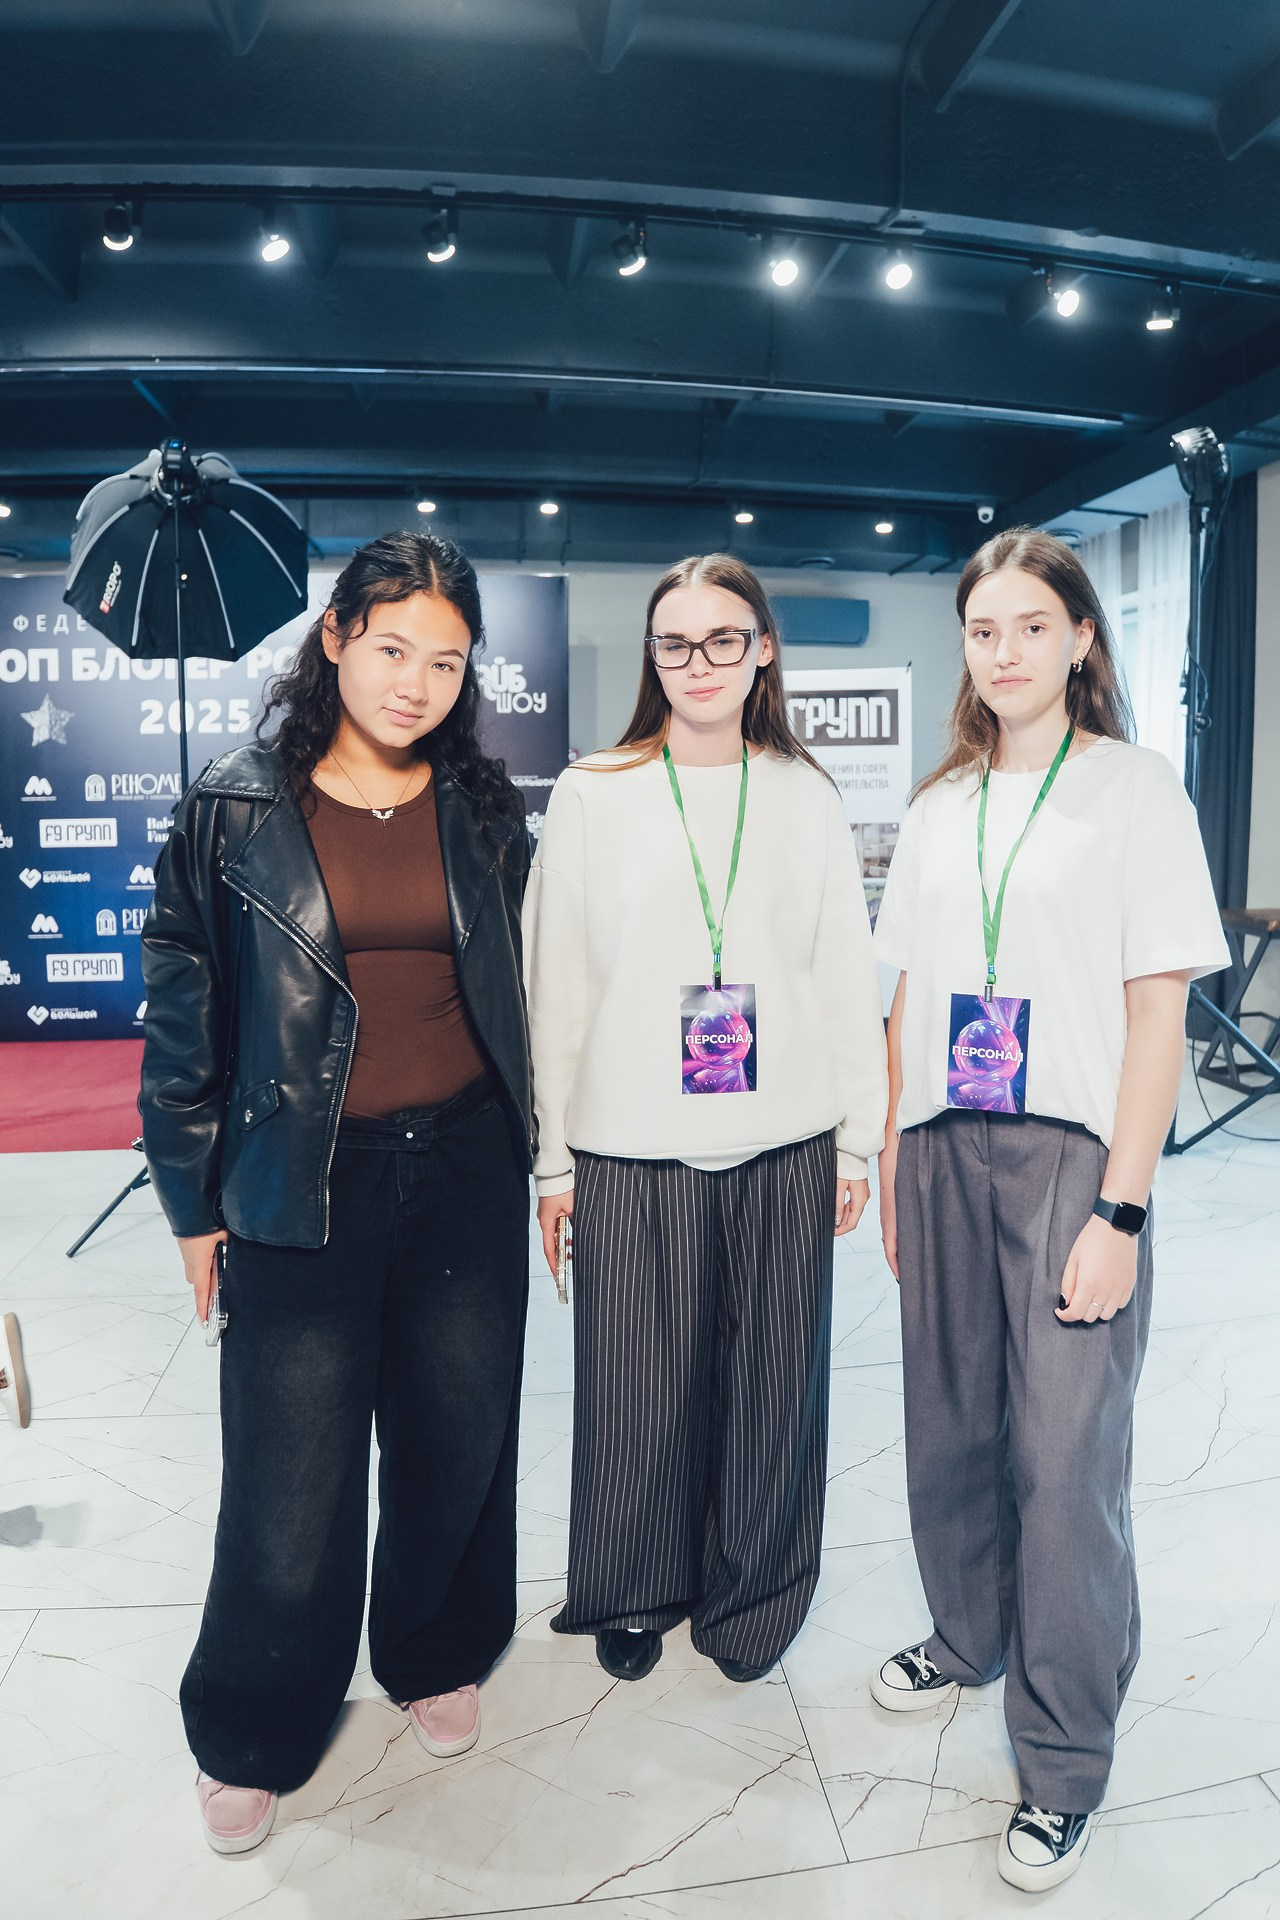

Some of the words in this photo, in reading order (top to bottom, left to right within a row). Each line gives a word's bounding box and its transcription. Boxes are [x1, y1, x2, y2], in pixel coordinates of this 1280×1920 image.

[13, 614, 87, 635] ФЕДЕ
[496, 691, 547, 713] ШОУ
[140, 699, 251, 735] 2025
[787, 696, 891, 739] ГРУПП
[855, 764, 861, 773] В
[862, 763, 888, 773] СФЕРЕ
[112, 773, 182, 795] РЕНОМЕ
[66, 824, 112, 841] ГРУПП
[73, 958, 118, 975] ГРУПП
[685, 1033, 753, 1045] ПЕРСОНАЛ
[952, 1045, 1023, 1062] ПЕРСОНАЛ
